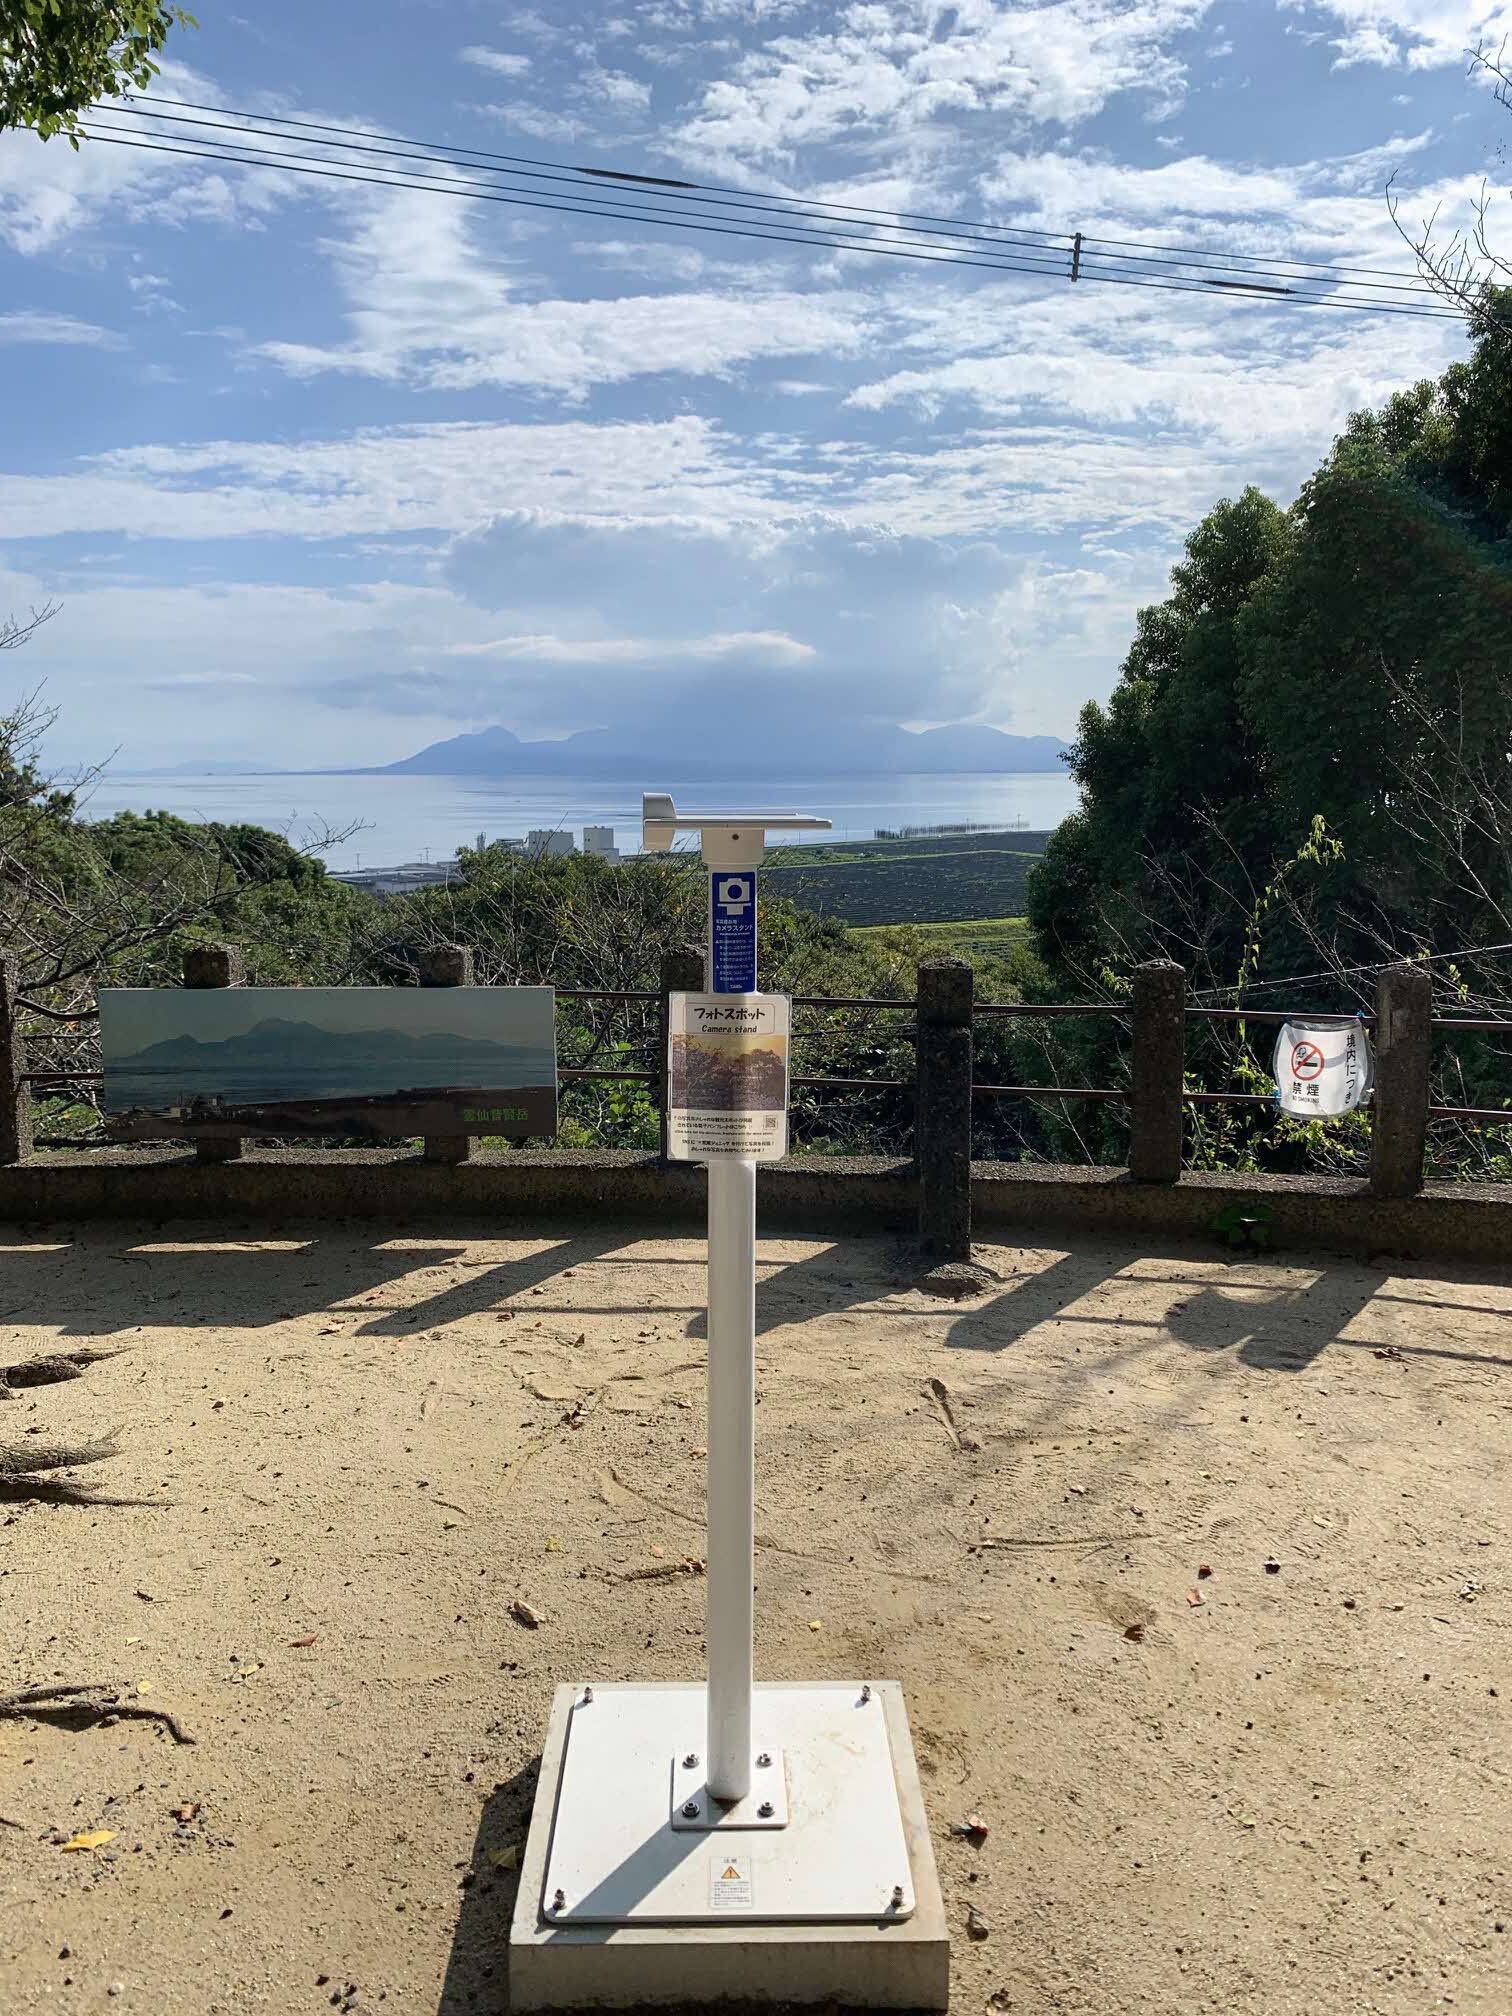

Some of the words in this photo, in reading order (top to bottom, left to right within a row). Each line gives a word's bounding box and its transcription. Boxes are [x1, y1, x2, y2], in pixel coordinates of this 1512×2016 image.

[694, 1008, 766, 1020] フォトスポット
[702, 1024, 732, 1033] Camera
[734, 1025, 758, 1033] stand
[1345, 1033, 1357, 1104] 境内につき
[1292, 1081, 1320, 1096] 禁煙
